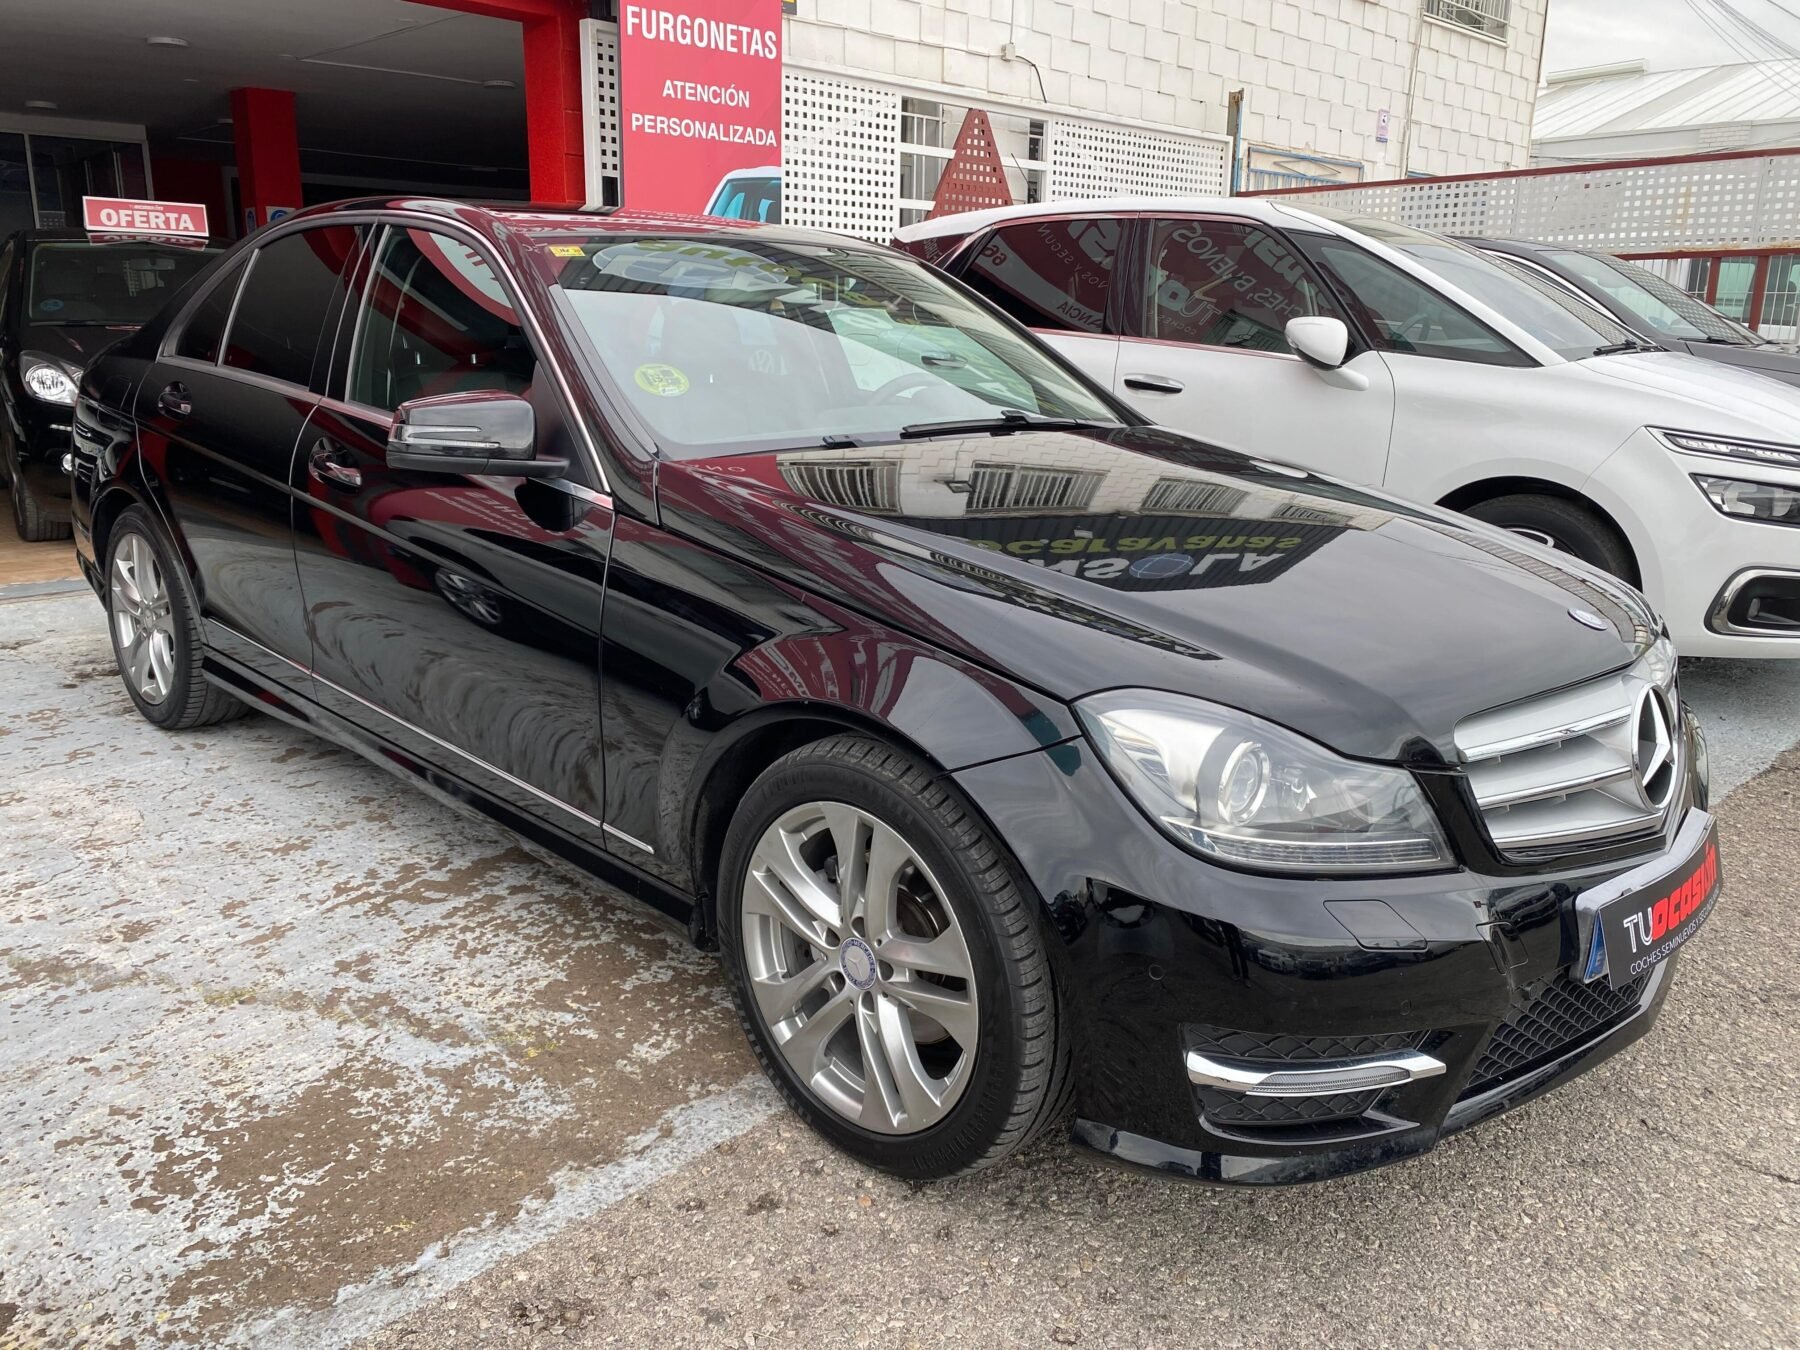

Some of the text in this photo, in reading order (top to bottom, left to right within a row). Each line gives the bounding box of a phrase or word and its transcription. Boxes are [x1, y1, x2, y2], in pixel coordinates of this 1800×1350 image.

[626, 5, 777, 59] FURGONETAS
[662, 79, 750, 108] ATENCIÓN
[631, 113, 777, 147] PERSONALIZADA
[100, 208, 195, 231] OFERTA
[1630, 948, 1662, 975] COCHES
